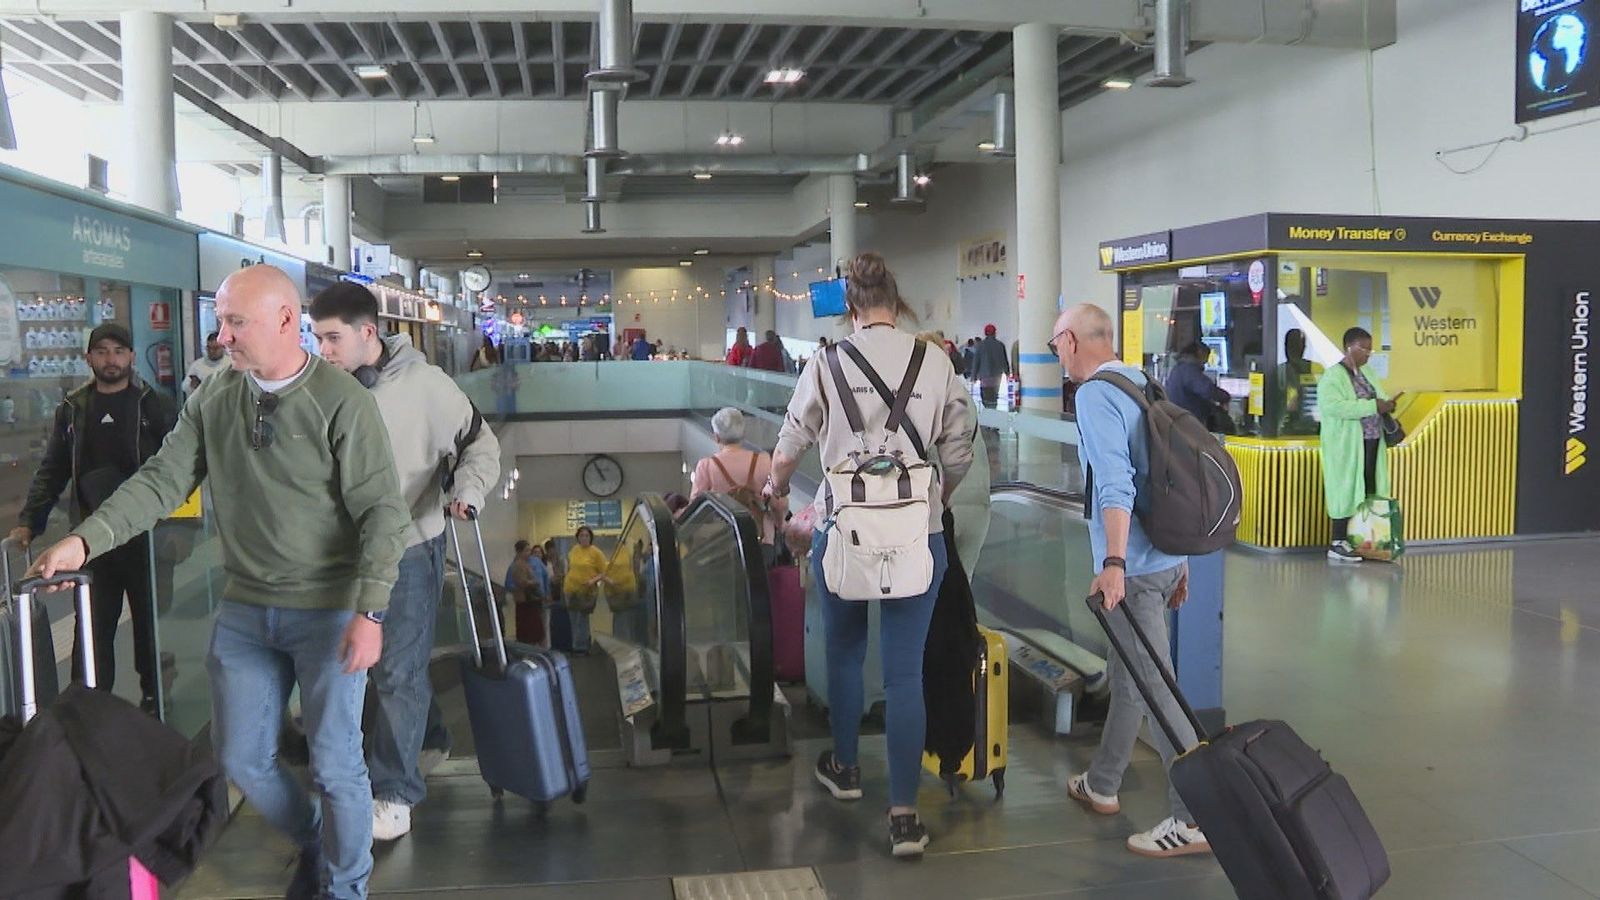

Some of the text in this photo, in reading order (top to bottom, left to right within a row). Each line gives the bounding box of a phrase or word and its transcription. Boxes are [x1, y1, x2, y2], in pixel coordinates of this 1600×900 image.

[73, 214, 131, 252] AROMAS
[1289, 226, 1393, 242] Money Transfer
[1432, 230, 1533, 245] Currency Exchange
[1114, 241, 1168, 263] Western Union
[1413, 315, 1477, 331] Western
[1413, 331, 1459, 346] Union
[1569, 291, 1590, 434] Western Union
